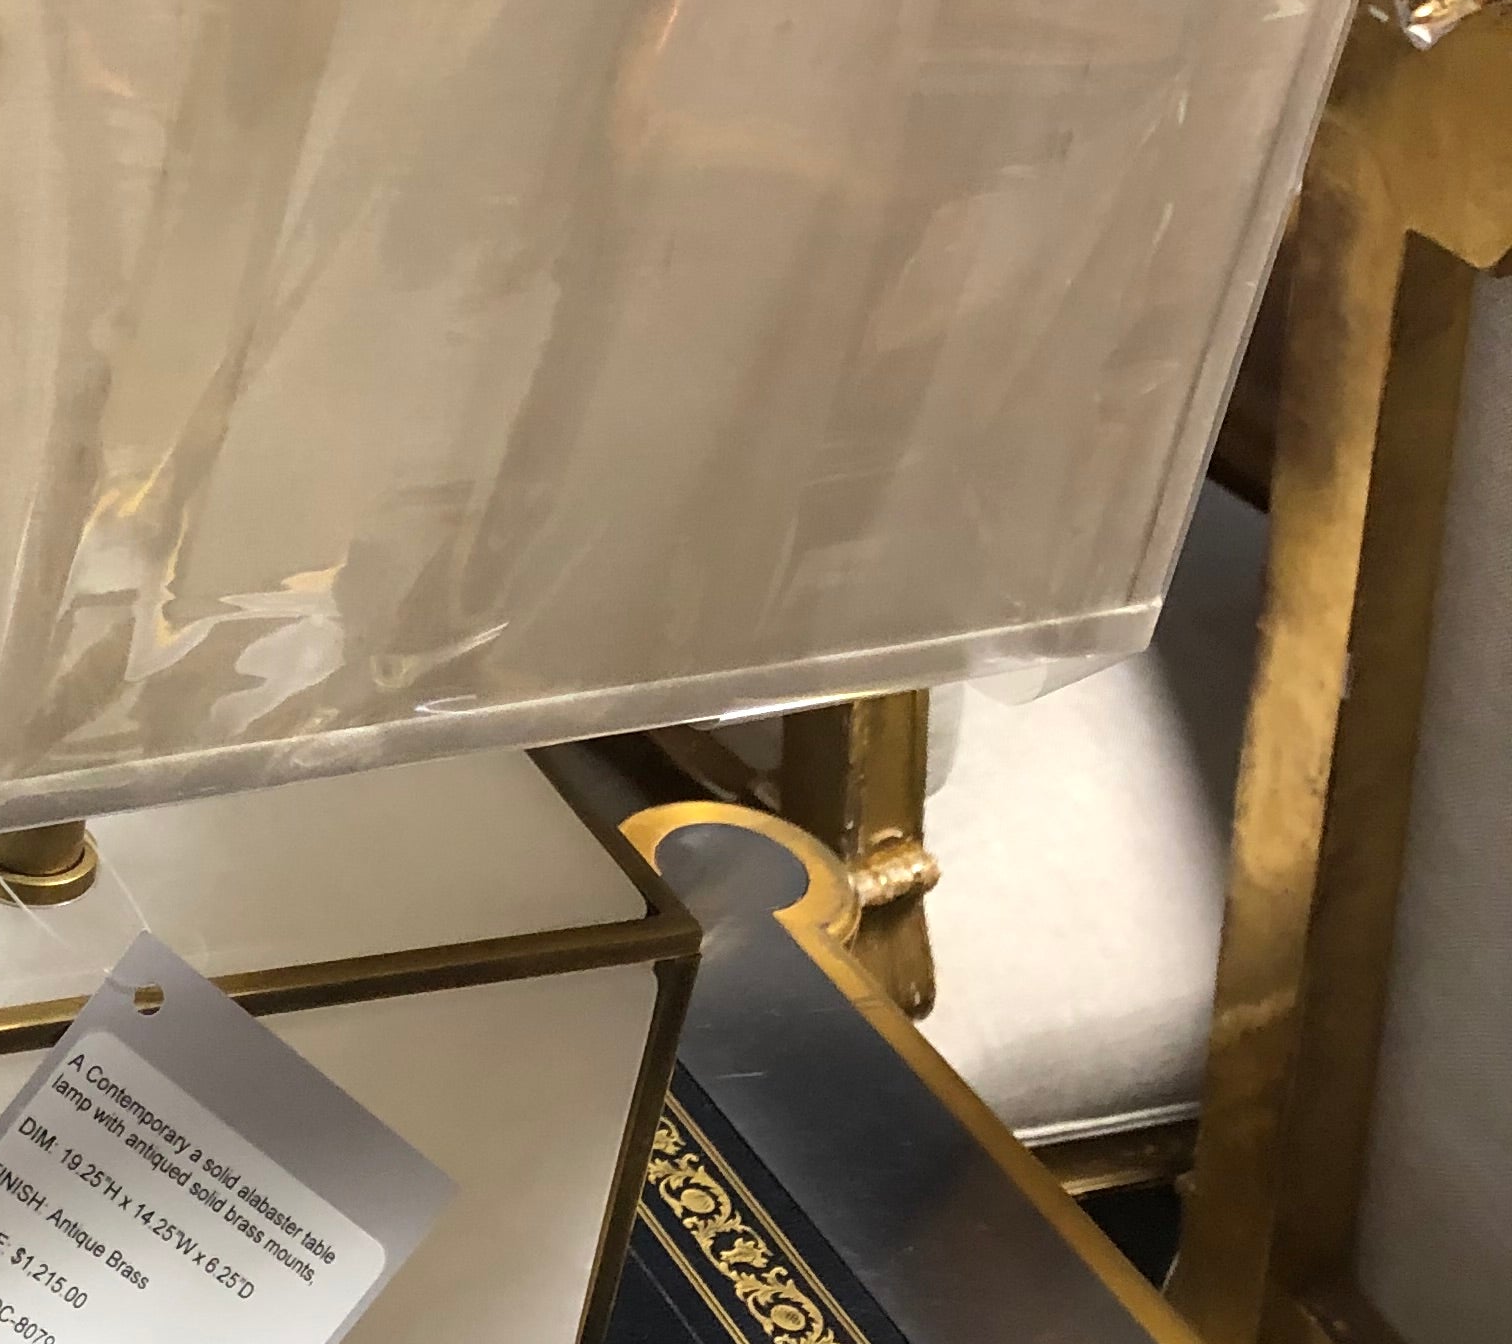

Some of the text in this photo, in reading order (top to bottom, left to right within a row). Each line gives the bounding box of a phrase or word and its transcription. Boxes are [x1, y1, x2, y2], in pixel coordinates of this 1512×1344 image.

[18, 1116, 255, 1299] DIM: 19.25"H x 14.25"W x 6.25"D
[46, 1208, 106, 1258] Antique
[105, 1250, 149, 1290] Brass
[51, 1073, 315, 1287] lamp with antiqued solid brass mounts,
[67, 1054, 336, 1265] A Contemporary a solid alabaster table
[10, 1247, 88, 1309] $1,215.00
